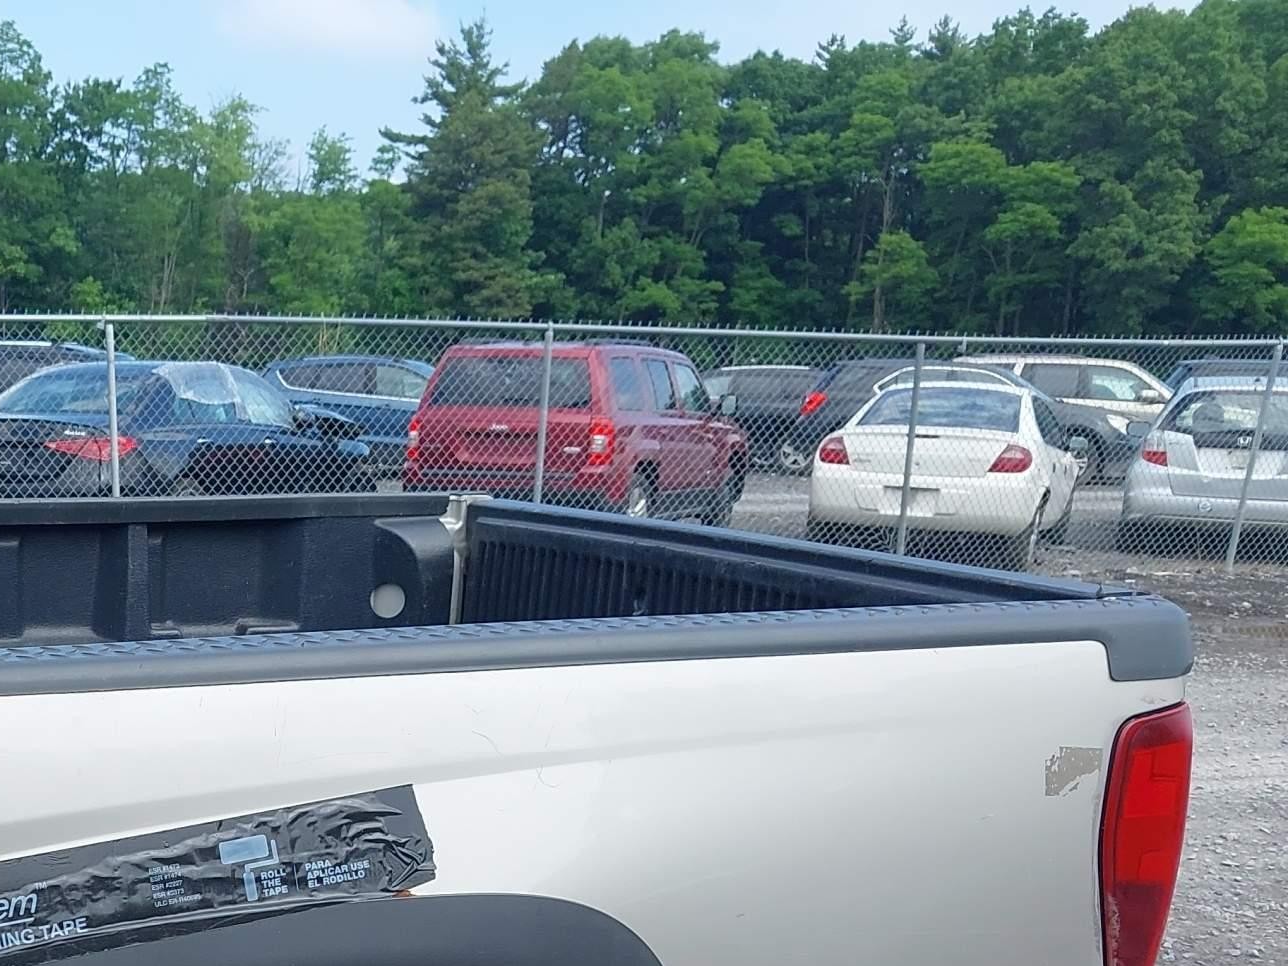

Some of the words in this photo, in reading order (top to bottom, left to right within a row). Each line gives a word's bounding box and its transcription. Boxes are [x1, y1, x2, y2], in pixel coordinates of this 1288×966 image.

[305, 859, 332, 871] PARA
[306, 864, 349, 880] APLICAR
[350, 859, 371, 872] USE
[260, 868, 287, 880] ROLL
[308, 879, 321, 889] EL
[322, 870, 366, 886] RODILLO
[261, 877, 282, 889] THE
[262, 885, 289, 897] TAPE
[38, 917, 89, 941] TAPE
